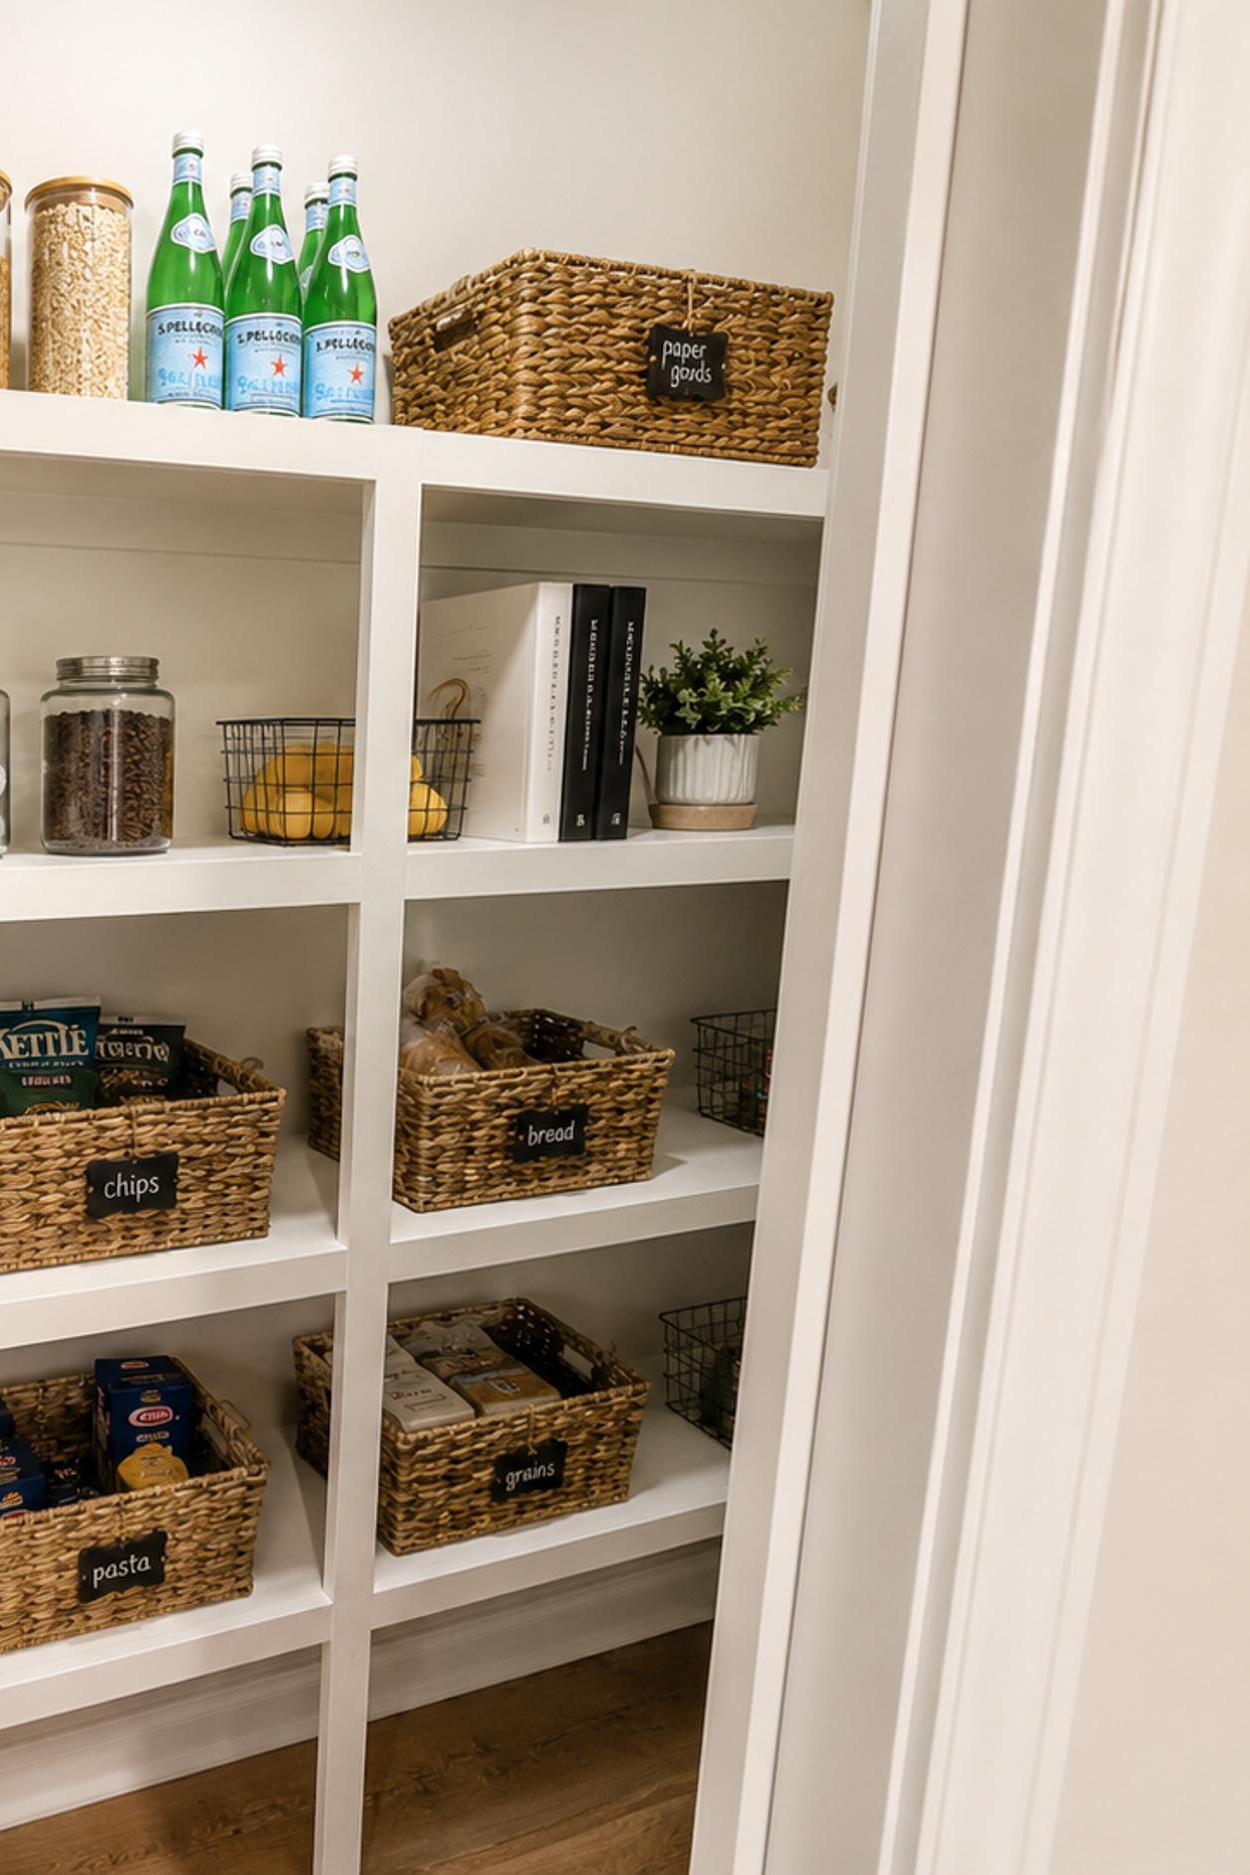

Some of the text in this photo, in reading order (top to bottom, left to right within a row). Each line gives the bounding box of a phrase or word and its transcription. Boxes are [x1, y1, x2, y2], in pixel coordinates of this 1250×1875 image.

[661, 340, 707, 370] paper
[527, 1122, 575, 1147] bread
[104, 1173, 160, 1203] chips
[505, 1461, 556, 1491] grains
[93, 1554, 151, 1589] pasta
